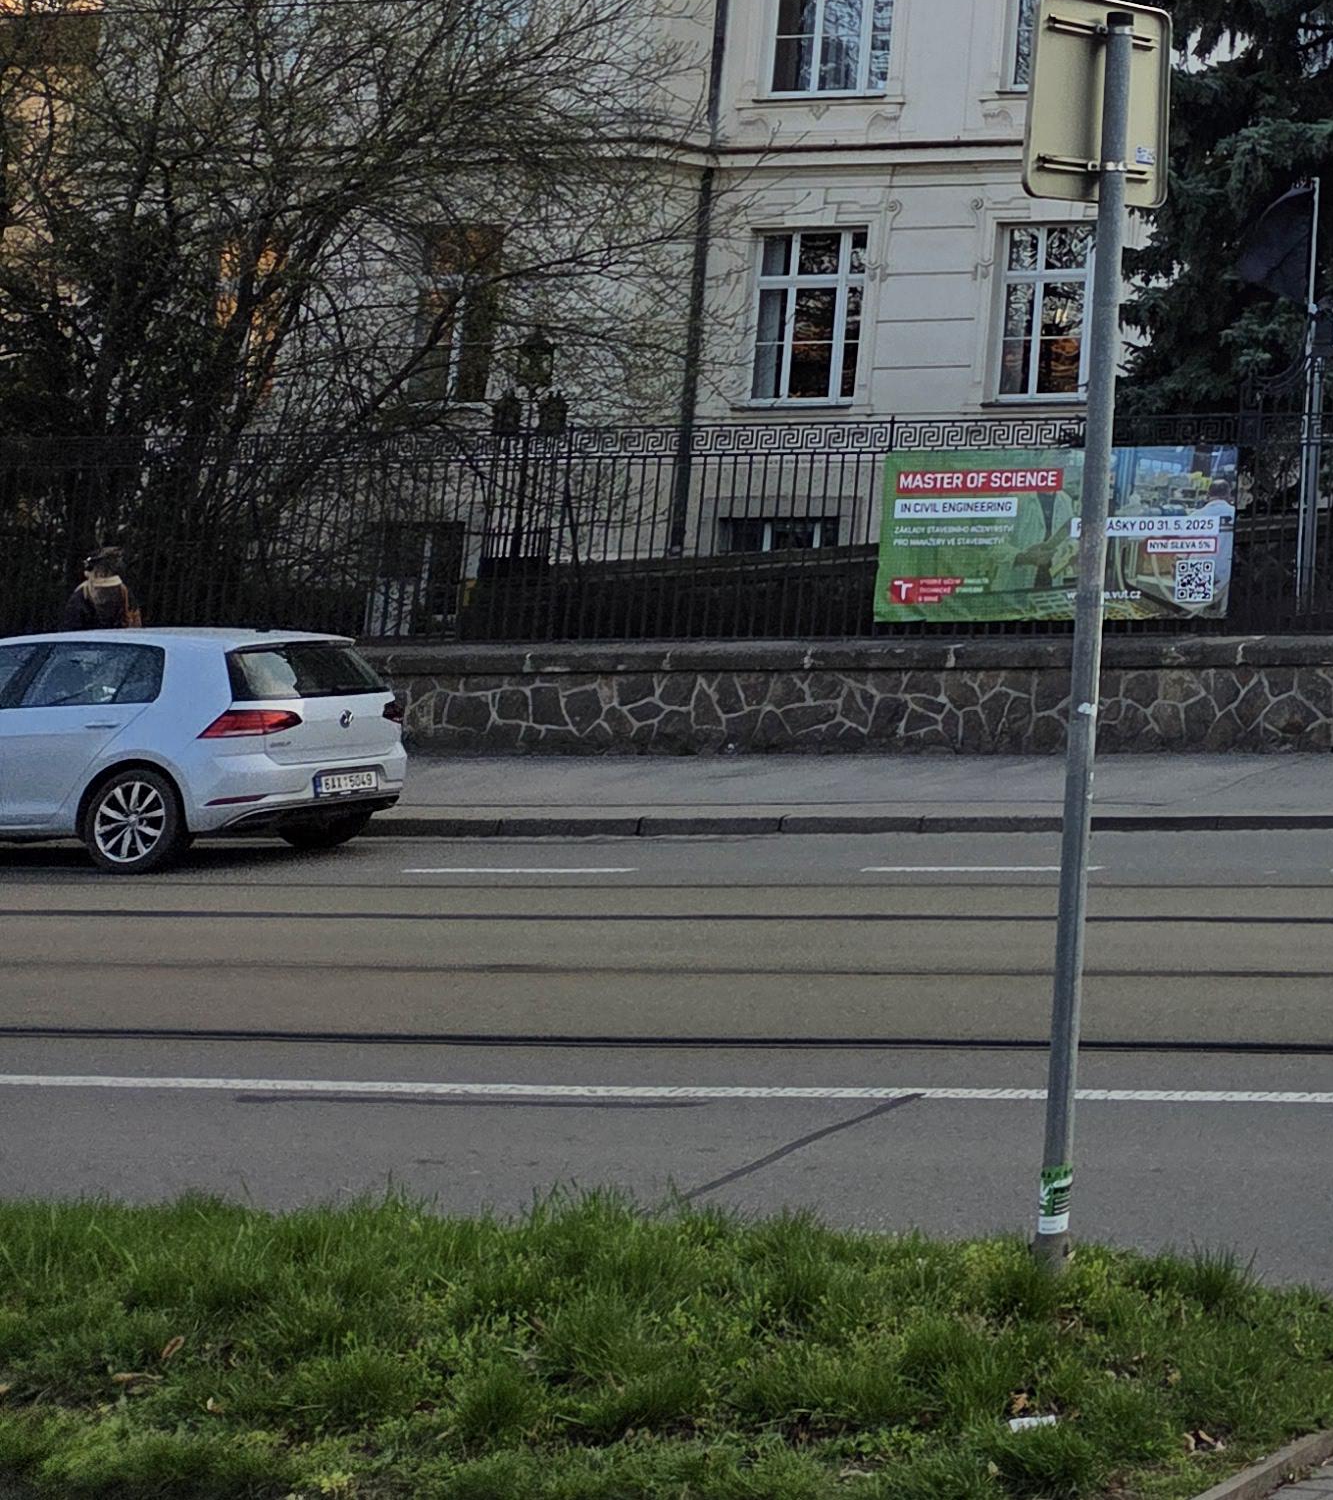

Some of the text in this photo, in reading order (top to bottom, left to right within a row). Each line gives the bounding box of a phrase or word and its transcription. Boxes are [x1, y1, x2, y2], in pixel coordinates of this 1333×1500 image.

[899, 471, 1058, 489] MASTER OF SCIENCE
[900, 501, 1012, 514] IN CIVIL ENGINEERING
[1139, 519, 1154, 531] DO
[1157, 519, 1171, 531] 31.
[1173, 519, 1182, 531] 5.
[1186, 519, 1214, 530] 2025
[1149, 540, 1169, 549] NYNÍ
[1171, 540, 1196, 549] SLEVA
